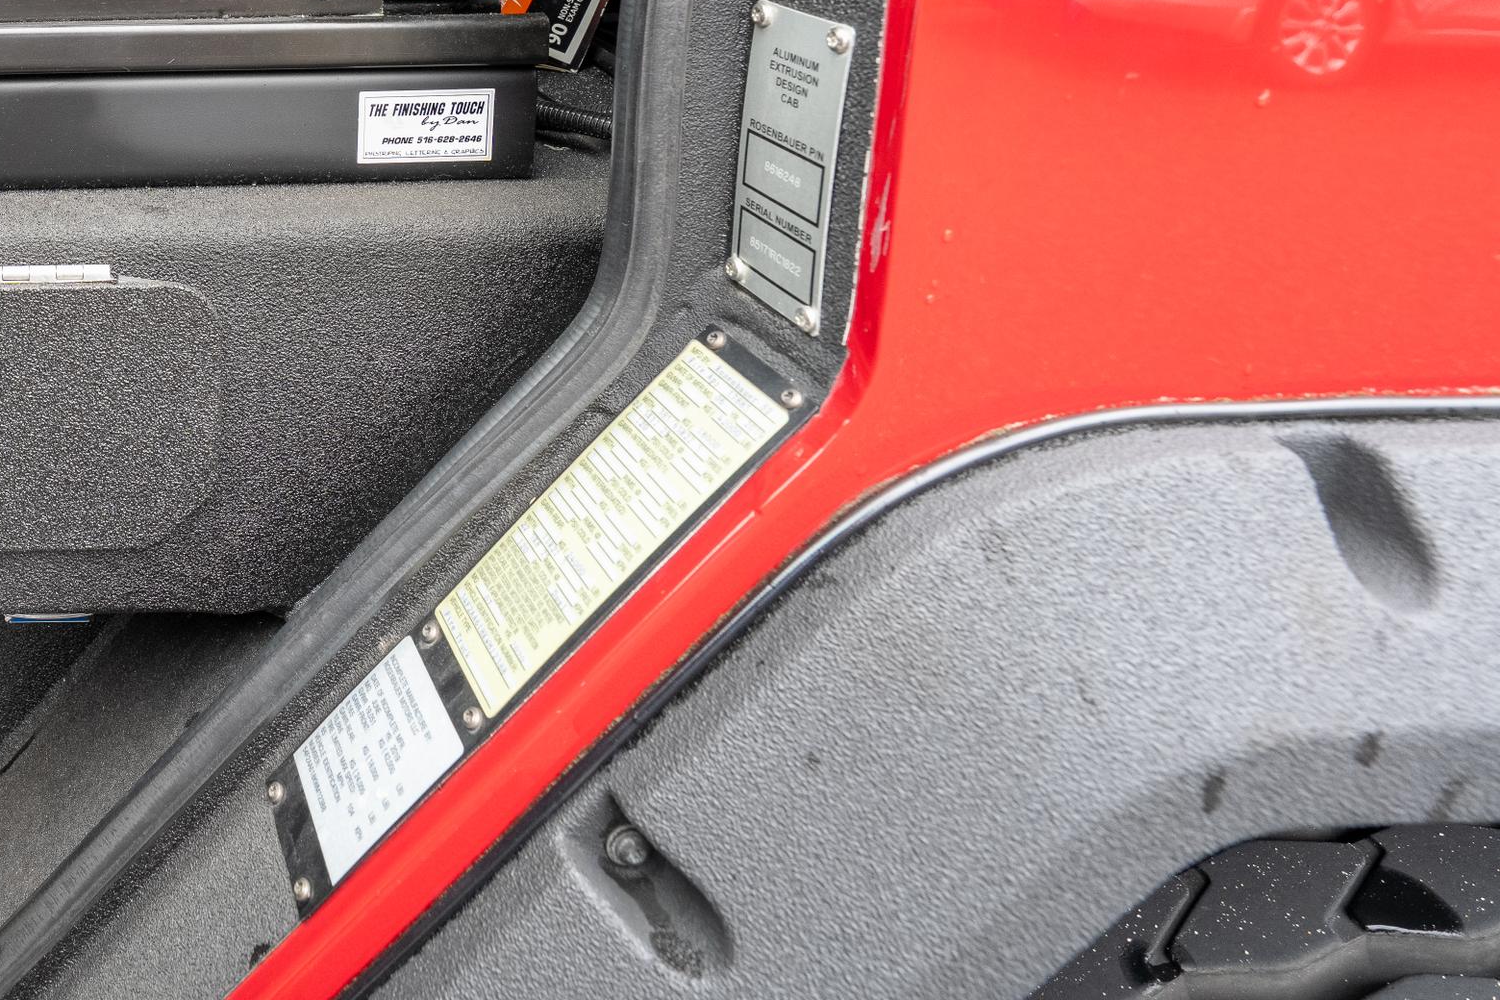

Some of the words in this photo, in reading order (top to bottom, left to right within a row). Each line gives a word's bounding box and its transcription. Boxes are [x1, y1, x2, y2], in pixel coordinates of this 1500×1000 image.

[564, 0, 581, 23] EXAM
[544, 19, 569, 48] 90
[772, 45, 819, 73] ALUMINUM
[769, 58, 819, 89] EXTRUSION
[775, 75, 808, 99] DESIGN
[369, 103, 389, 117] THE
[392, 102, 446, 117] FINISHING
[450, 101, 485, 116] TOUCH
[780, 91, 799, 109] CAB
[443, 116, 479, 125] Dan
[382, 137, 414, 145] PHONE
[417, 135, 482, 144] 516-628-2646
[749, 116, 807, 155] ROSENBAUER
[744, 195, 773, 222] SERIAL
[774, 213, 812, 246] NUMBER
